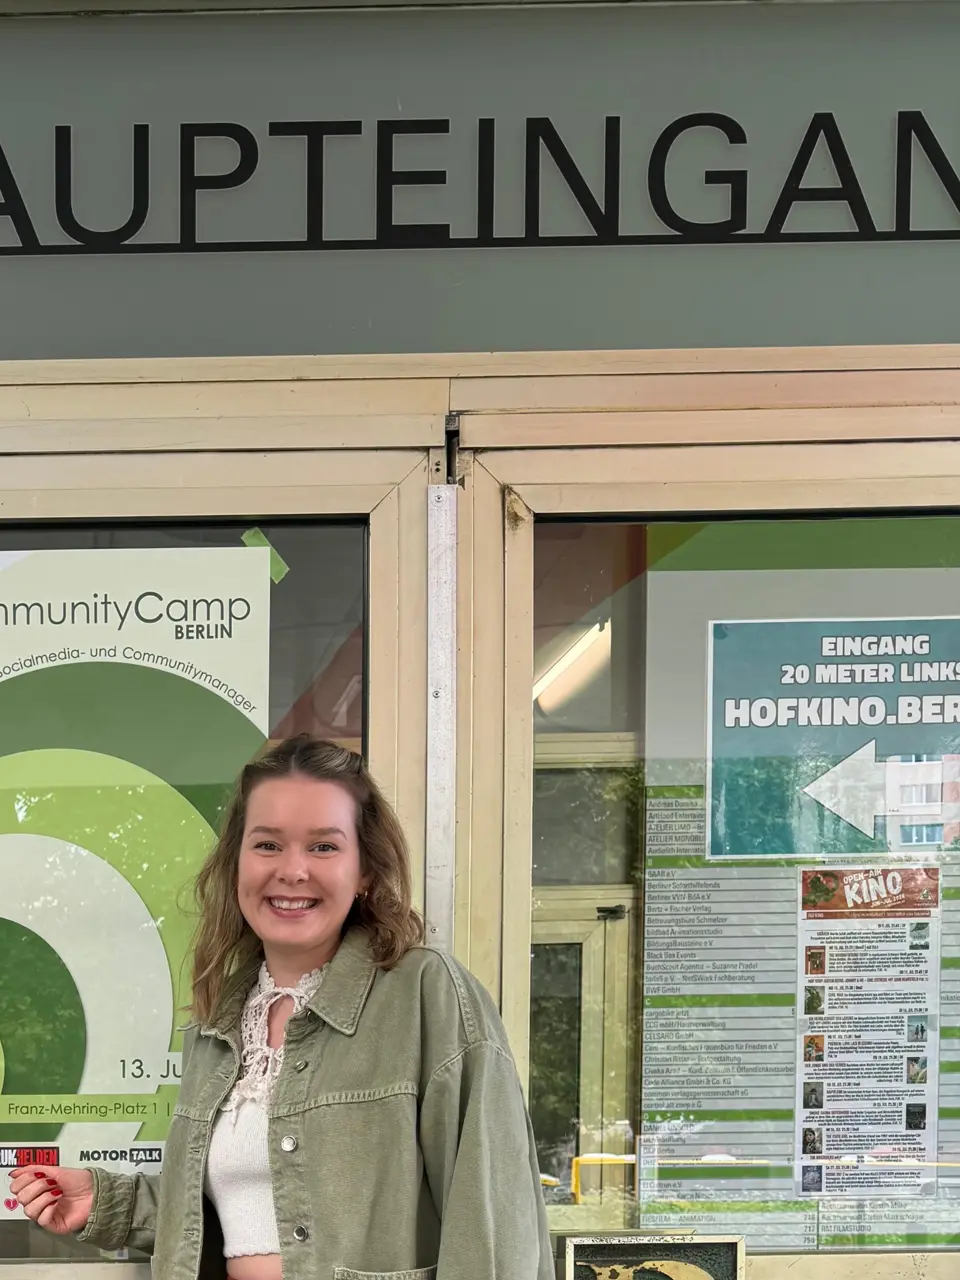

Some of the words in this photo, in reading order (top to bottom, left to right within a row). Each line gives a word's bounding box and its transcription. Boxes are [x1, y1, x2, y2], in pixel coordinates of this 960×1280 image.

[174, 624, 233, 641] BERLIN
[821, 634, 930, 657] EINGANG
[89, 645, 117, 658] und
[122, 646, 257, 713] Communitymanager
[780, 664, 810, 684] 20
[815, 662, 895, 684] METER
[724, 695, 960, 728] HOFKINO.BER
[844, 872, 903, 908] KINO
[692, 905, 712, 914] Verlag
[712, 962, 738, 970] Suzanne
[714, 974, 756, 982] Fachberatung
[662, 986, 680, 994] GmbH
[646, 1010, 674, 1018] cargobike
[676, 1010, 689, 1018] jetzt
[735, 1042, 744, 1050] für
[744, 1042, 767, 1050] Frieden
[120, 1058, 152, 1079] 13.
[661, 1078, 685, 1086] Alliance
[686, 1078, 705, 1086] GmbH
[8, 1101, 147, 1117] Franz-Mehring-Platz
[79, 1150, 128, 1162] MOTOR
[132, 1150, 160, 1160] TALK
